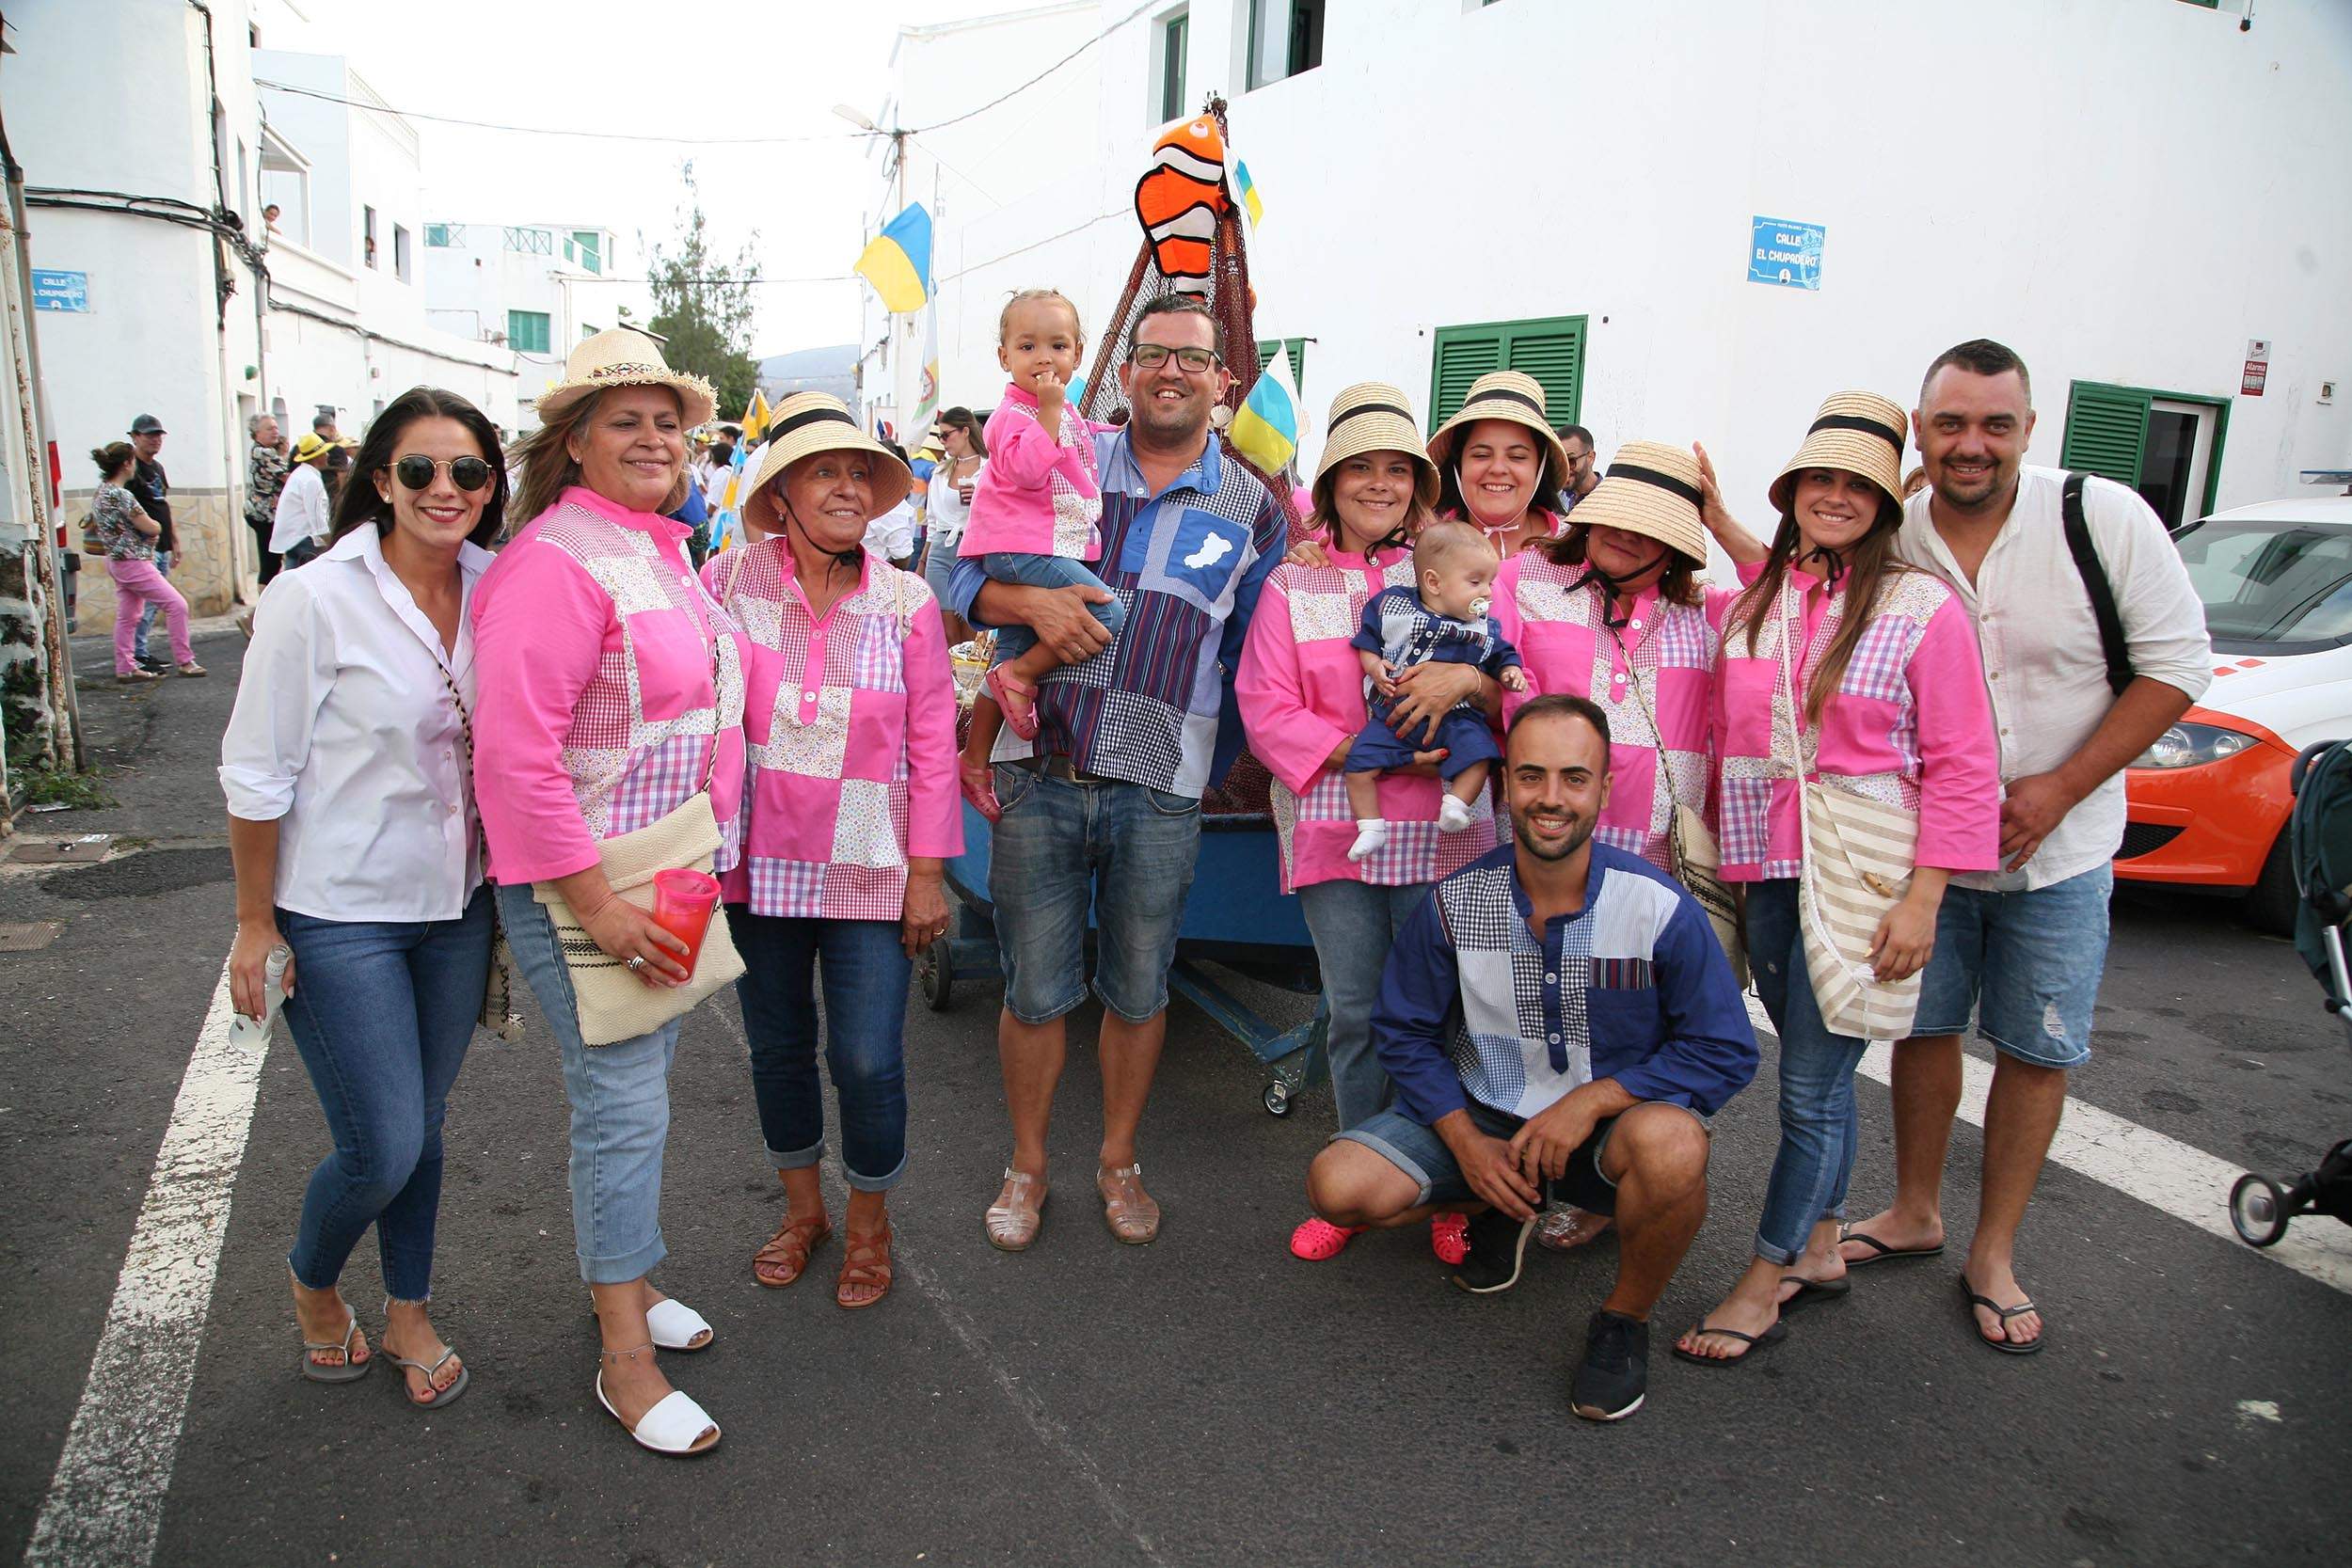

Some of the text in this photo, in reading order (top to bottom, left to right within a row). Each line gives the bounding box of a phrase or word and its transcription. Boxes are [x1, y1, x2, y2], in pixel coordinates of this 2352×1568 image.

[1776, 233, 1801, 246] CALLE
[1756, 248, 1816, 267] EL CHUPADERO
[2245, 362, 2265, 372] Alarma
